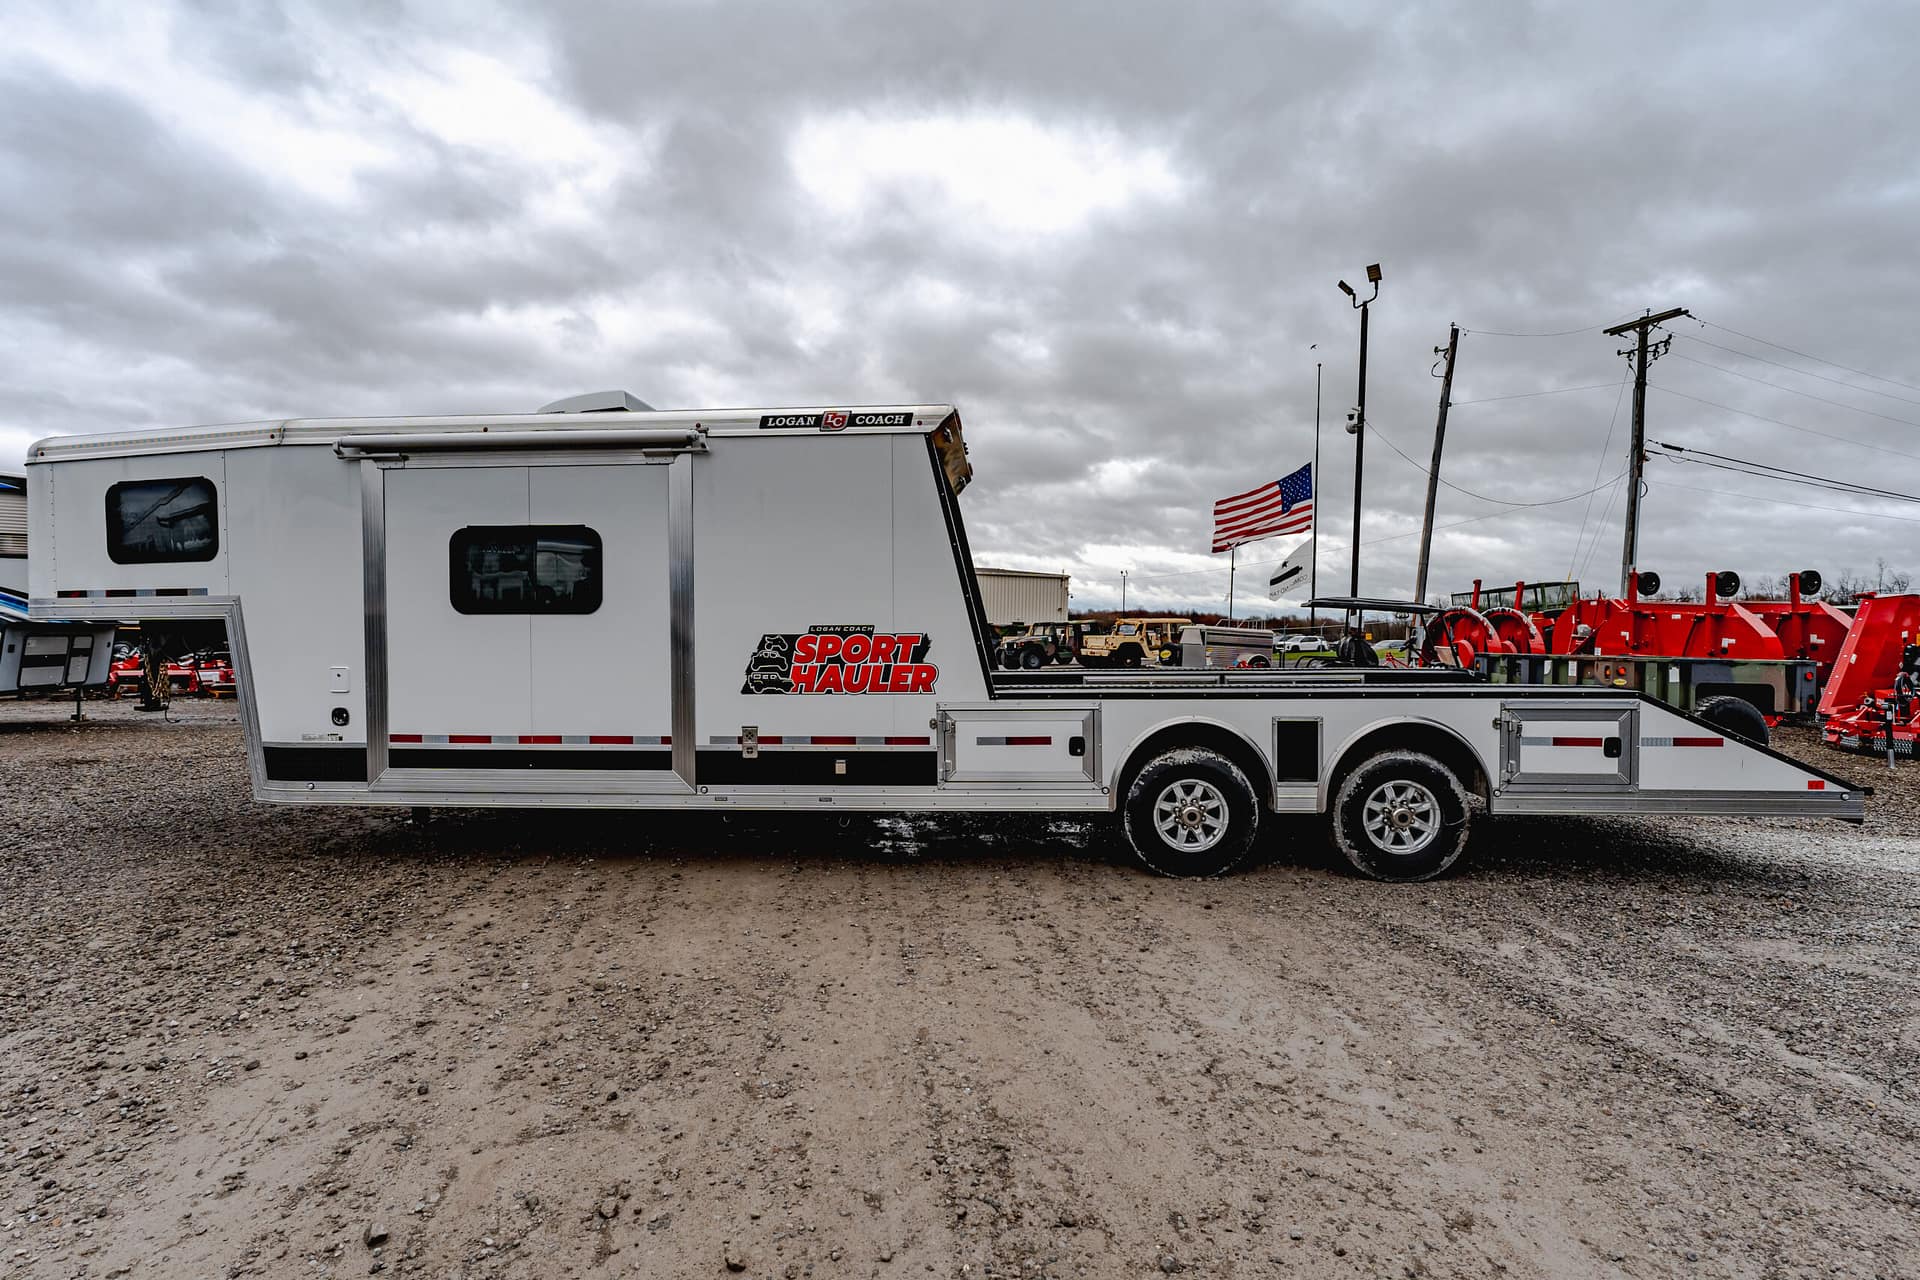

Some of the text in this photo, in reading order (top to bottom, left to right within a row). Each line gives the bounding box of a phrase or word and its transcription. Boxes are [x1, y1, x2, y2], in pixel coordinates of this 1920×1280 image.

[767, 413, 905, 427] LOGAN LC COACH
[793, 633, 921, 663] SPORT
[791, 664, 938, 694] HAULER
